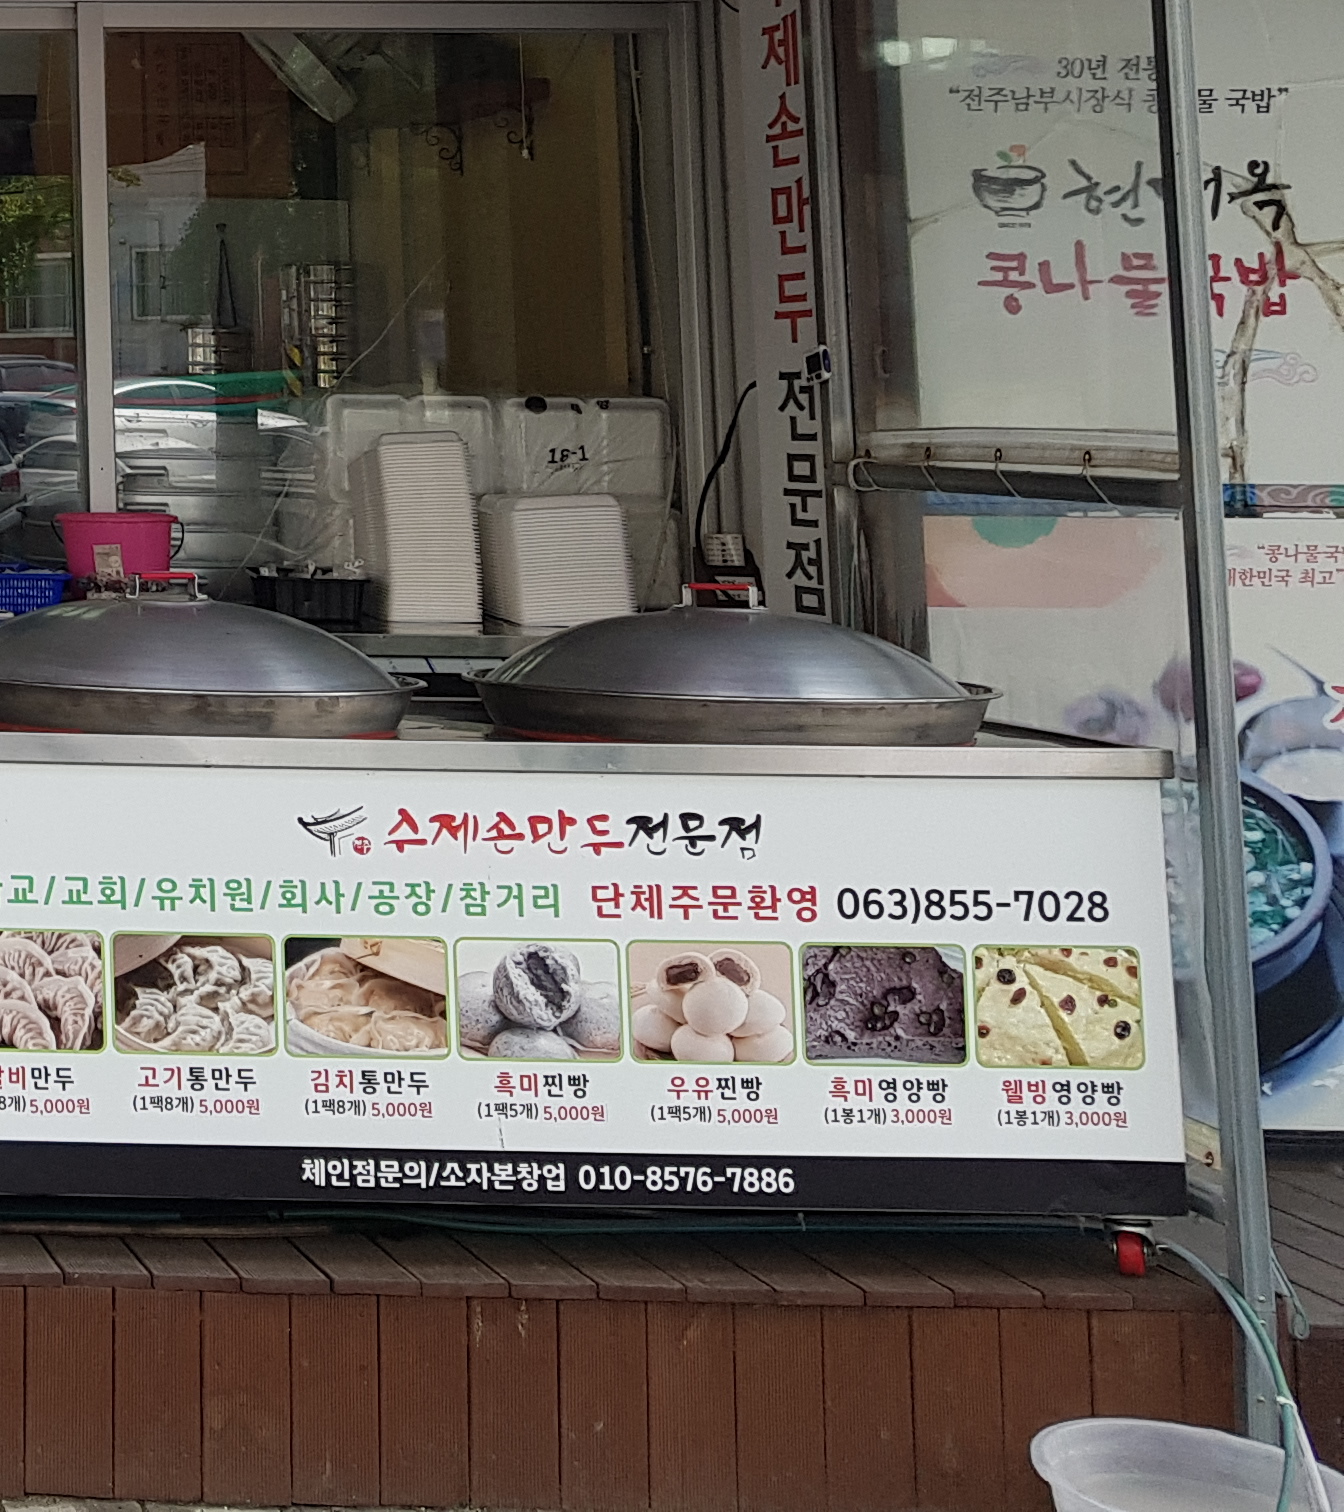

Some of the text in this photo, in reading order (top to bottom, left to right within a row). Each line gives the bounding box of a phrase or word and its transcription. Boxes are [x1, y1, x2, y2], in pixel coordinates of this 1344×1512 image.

[1056, 57, 1108, 80] 30년
[777, 367, 826, 616] 전문점
[384, 808, 761, 860] 수제손만두전문점
[591, 883, 817, 922] 단체주문환영
[837, 888, 1109, 924] 063)855-7028
[138, 1067, 256, 1092] 고기통만두
[311, 1069, 429, 1095] 김치통만두
[494, 1072, 589, 1098] 흑미찐빵
[667, 1076, 762, 1101] 우유찐빵
[829, 1077, 948, 1103] 흑미영양빵
[133, 1095, 260, 1115] (1팩8개) 5,000원
[1002, 1080, 1123, 1106] 웰빙영양빵
[30, 1098, 90, 1115] 5,000원
[305, 1099, 432, 1118] (1팩8개) 5,000원
[478, 1102, 605, 1122] (1팩5개) 5,000원
[651, 1105, 778, 1125] (1팩5개) 5,000원
[825, 1108, 952, 1125] (1봉1개) 3,000원
[998, 1110, 1128, 1128] (1봉1개) 3,000원
[301, 1158, 795, 1194] 체인점문의/소자본창업 010-8576-7886
